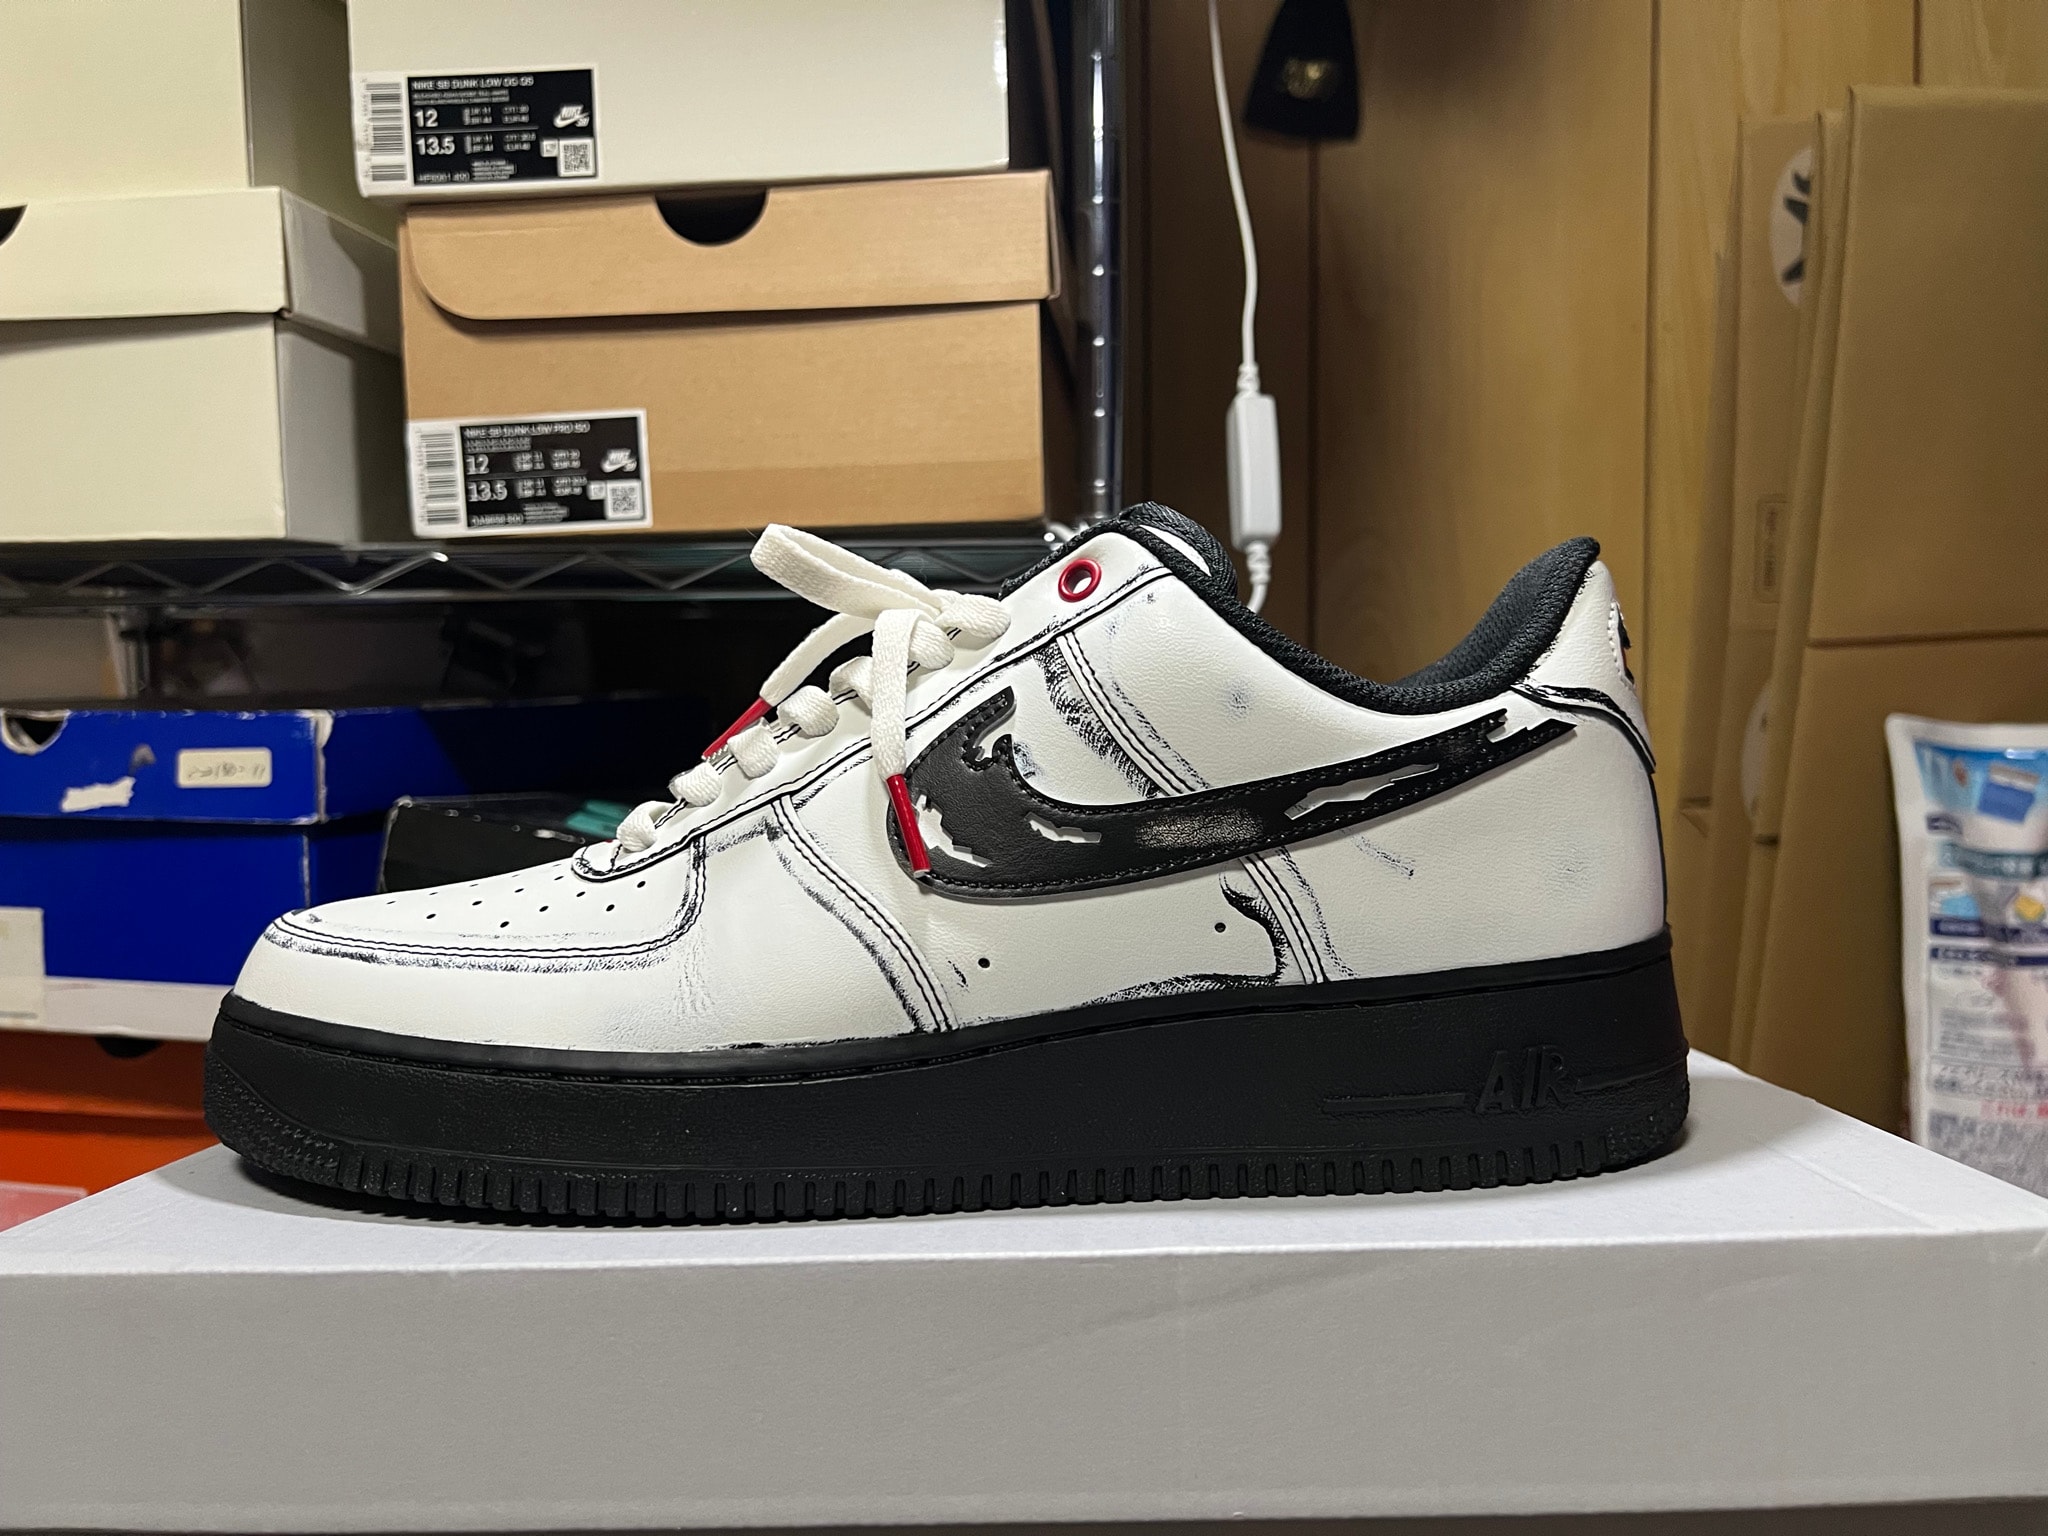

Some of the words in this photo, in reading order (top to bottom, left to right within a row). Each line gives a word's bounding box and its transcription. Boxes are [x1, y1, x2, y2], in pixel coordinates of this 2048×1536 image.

[411, 80, 434, 91] NIKE
[436, 79, 450, 90] SB
[451, 78, 479, 90] DUNK
[480, 77, 502, 89] LOW
[415, 109, 439, 128] 12
[560, 104, 584, 119] NIKE
[416, 135, 456, 156] 13.5
[465, 455, 490, 475] 12
[467, 479, 508, 502] 13.5
[1475, 1044, 1572, 1115] AIR
